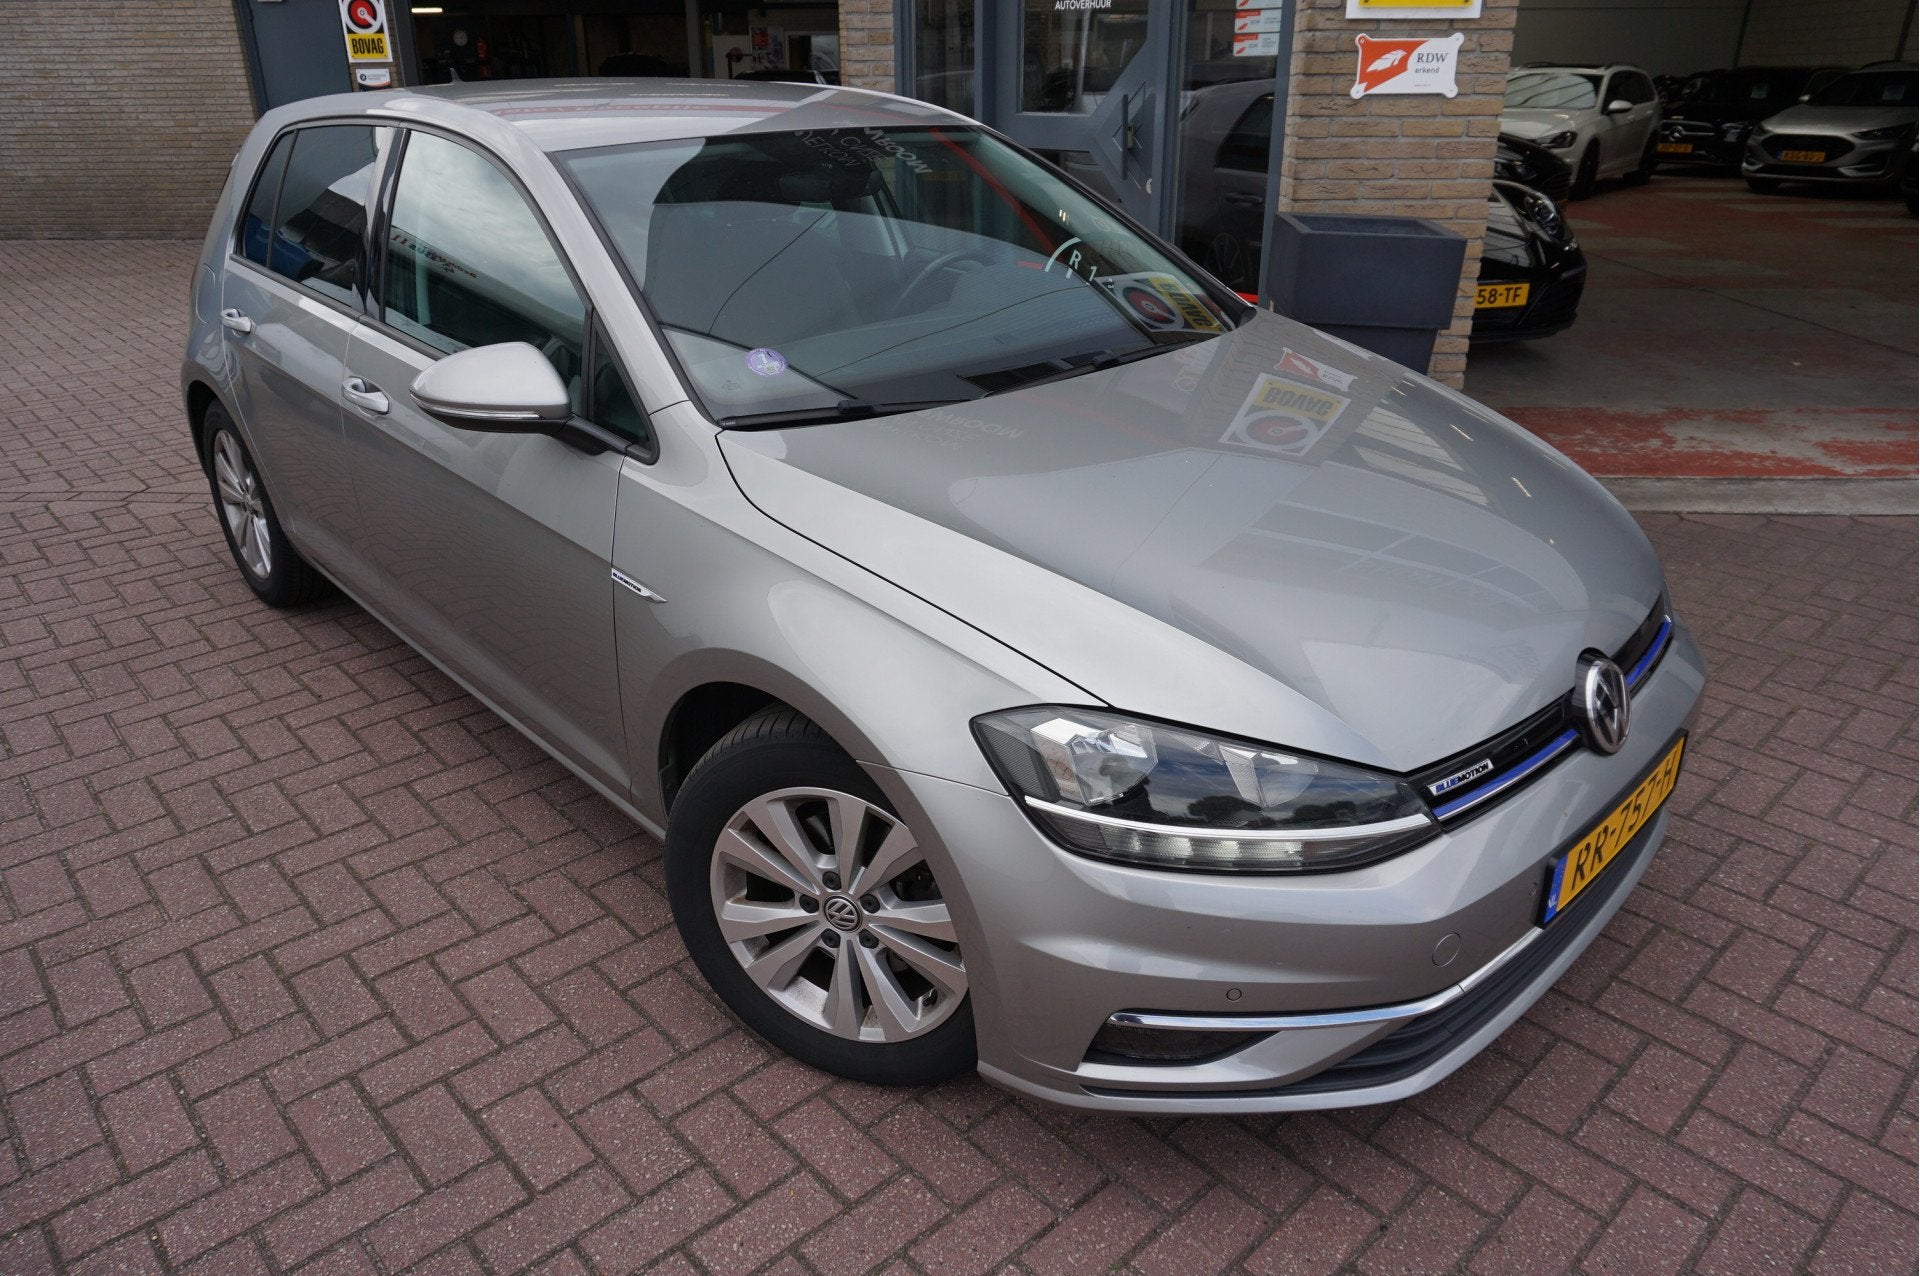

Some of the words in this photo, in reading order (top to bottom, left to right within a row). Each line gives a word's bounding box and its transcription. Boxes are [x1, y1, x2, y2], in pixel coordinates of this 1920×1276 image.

[1055, 0, 1112, 10] AUTOVERHUUR
[351, 38, 384, 54] BOVAG
[1416, 52, 1448, 63] RDW
[1414, 66, 1440, 74] erkend
[1476, 286, 1523, 305] 58-TF
[1435, 762, 1489, 794] BLUEMOTION
[1571, 750, 1678, 892] RR-757-H
